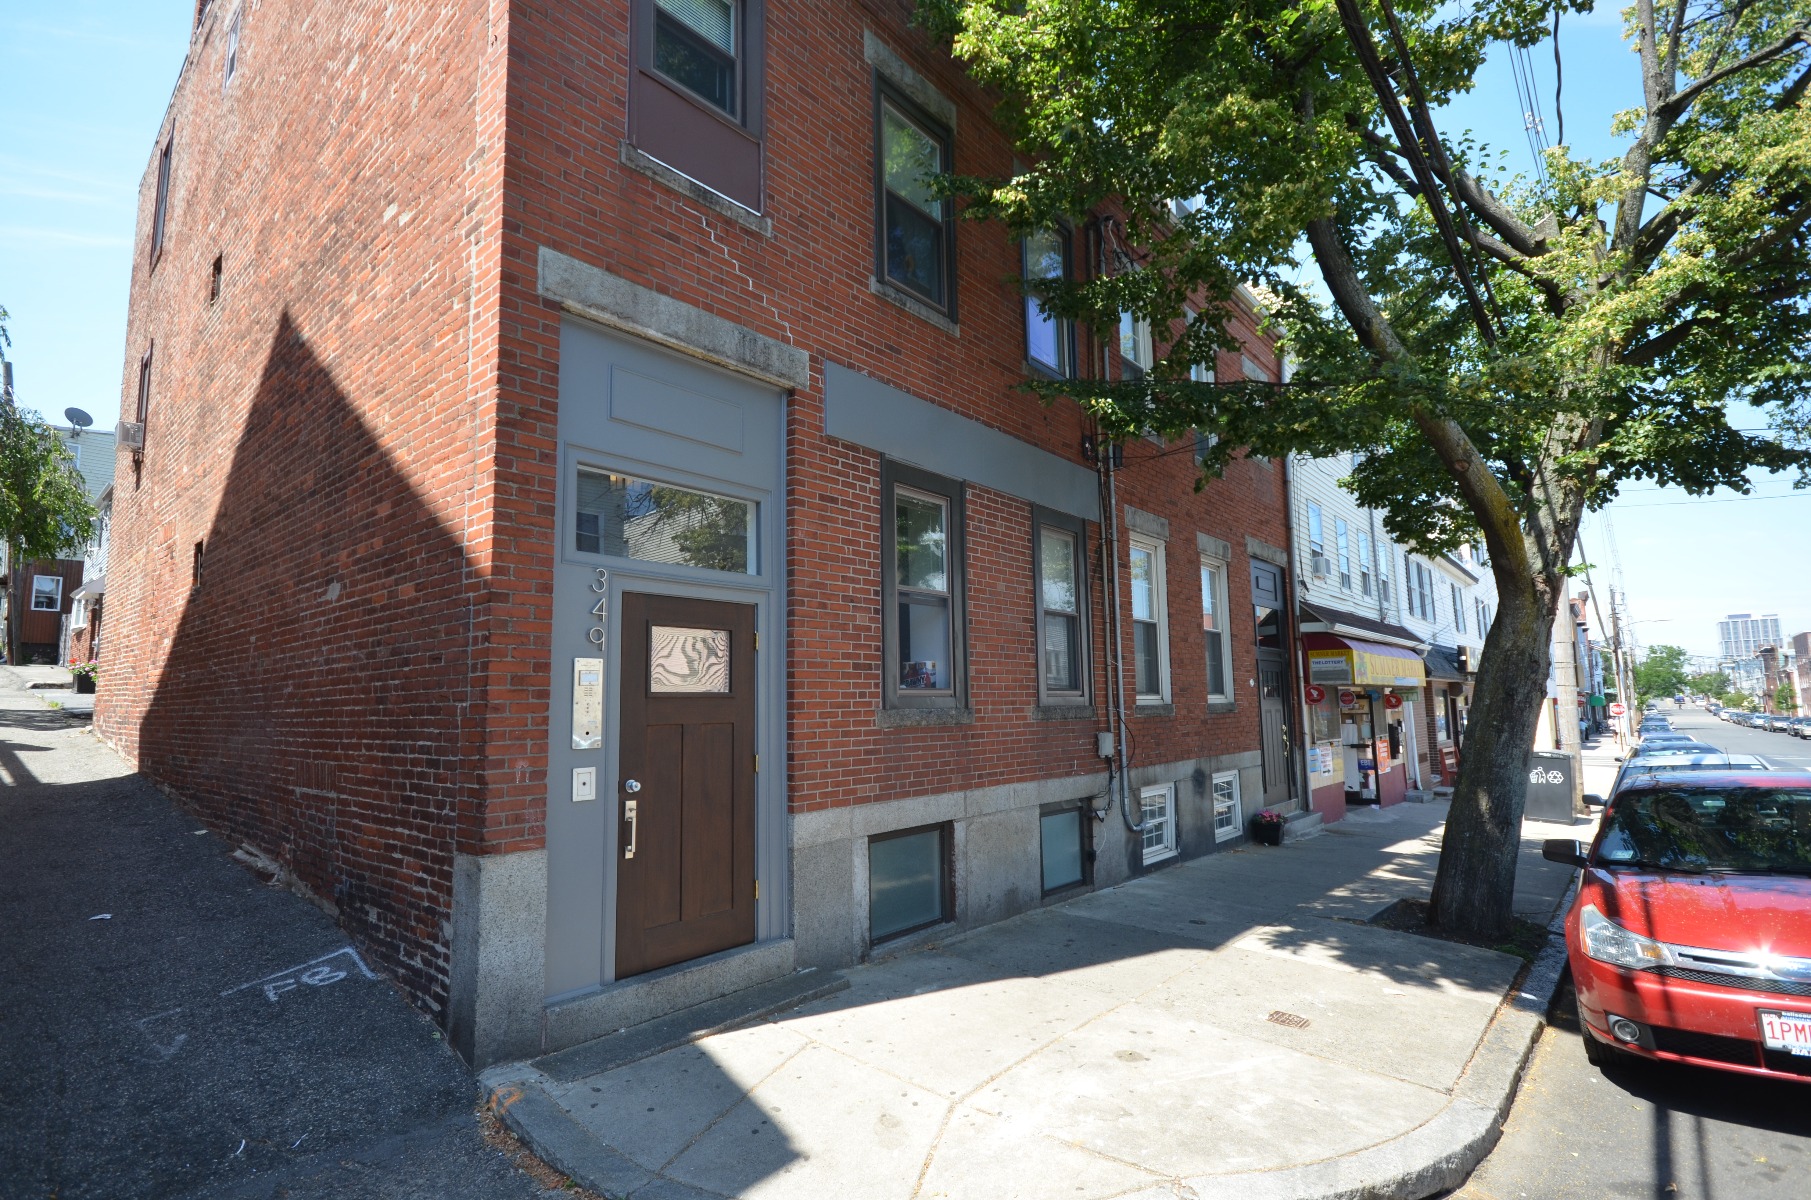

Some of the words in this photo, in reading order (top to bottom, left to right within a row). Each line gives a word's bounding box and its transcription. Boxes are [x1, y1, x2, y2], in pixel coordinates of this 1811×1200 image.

[589, 568, 607, 651] 349
[1370, 655, 1399, 675] SUMNER
[1767, 1020, 1811, 1042] 1PM
